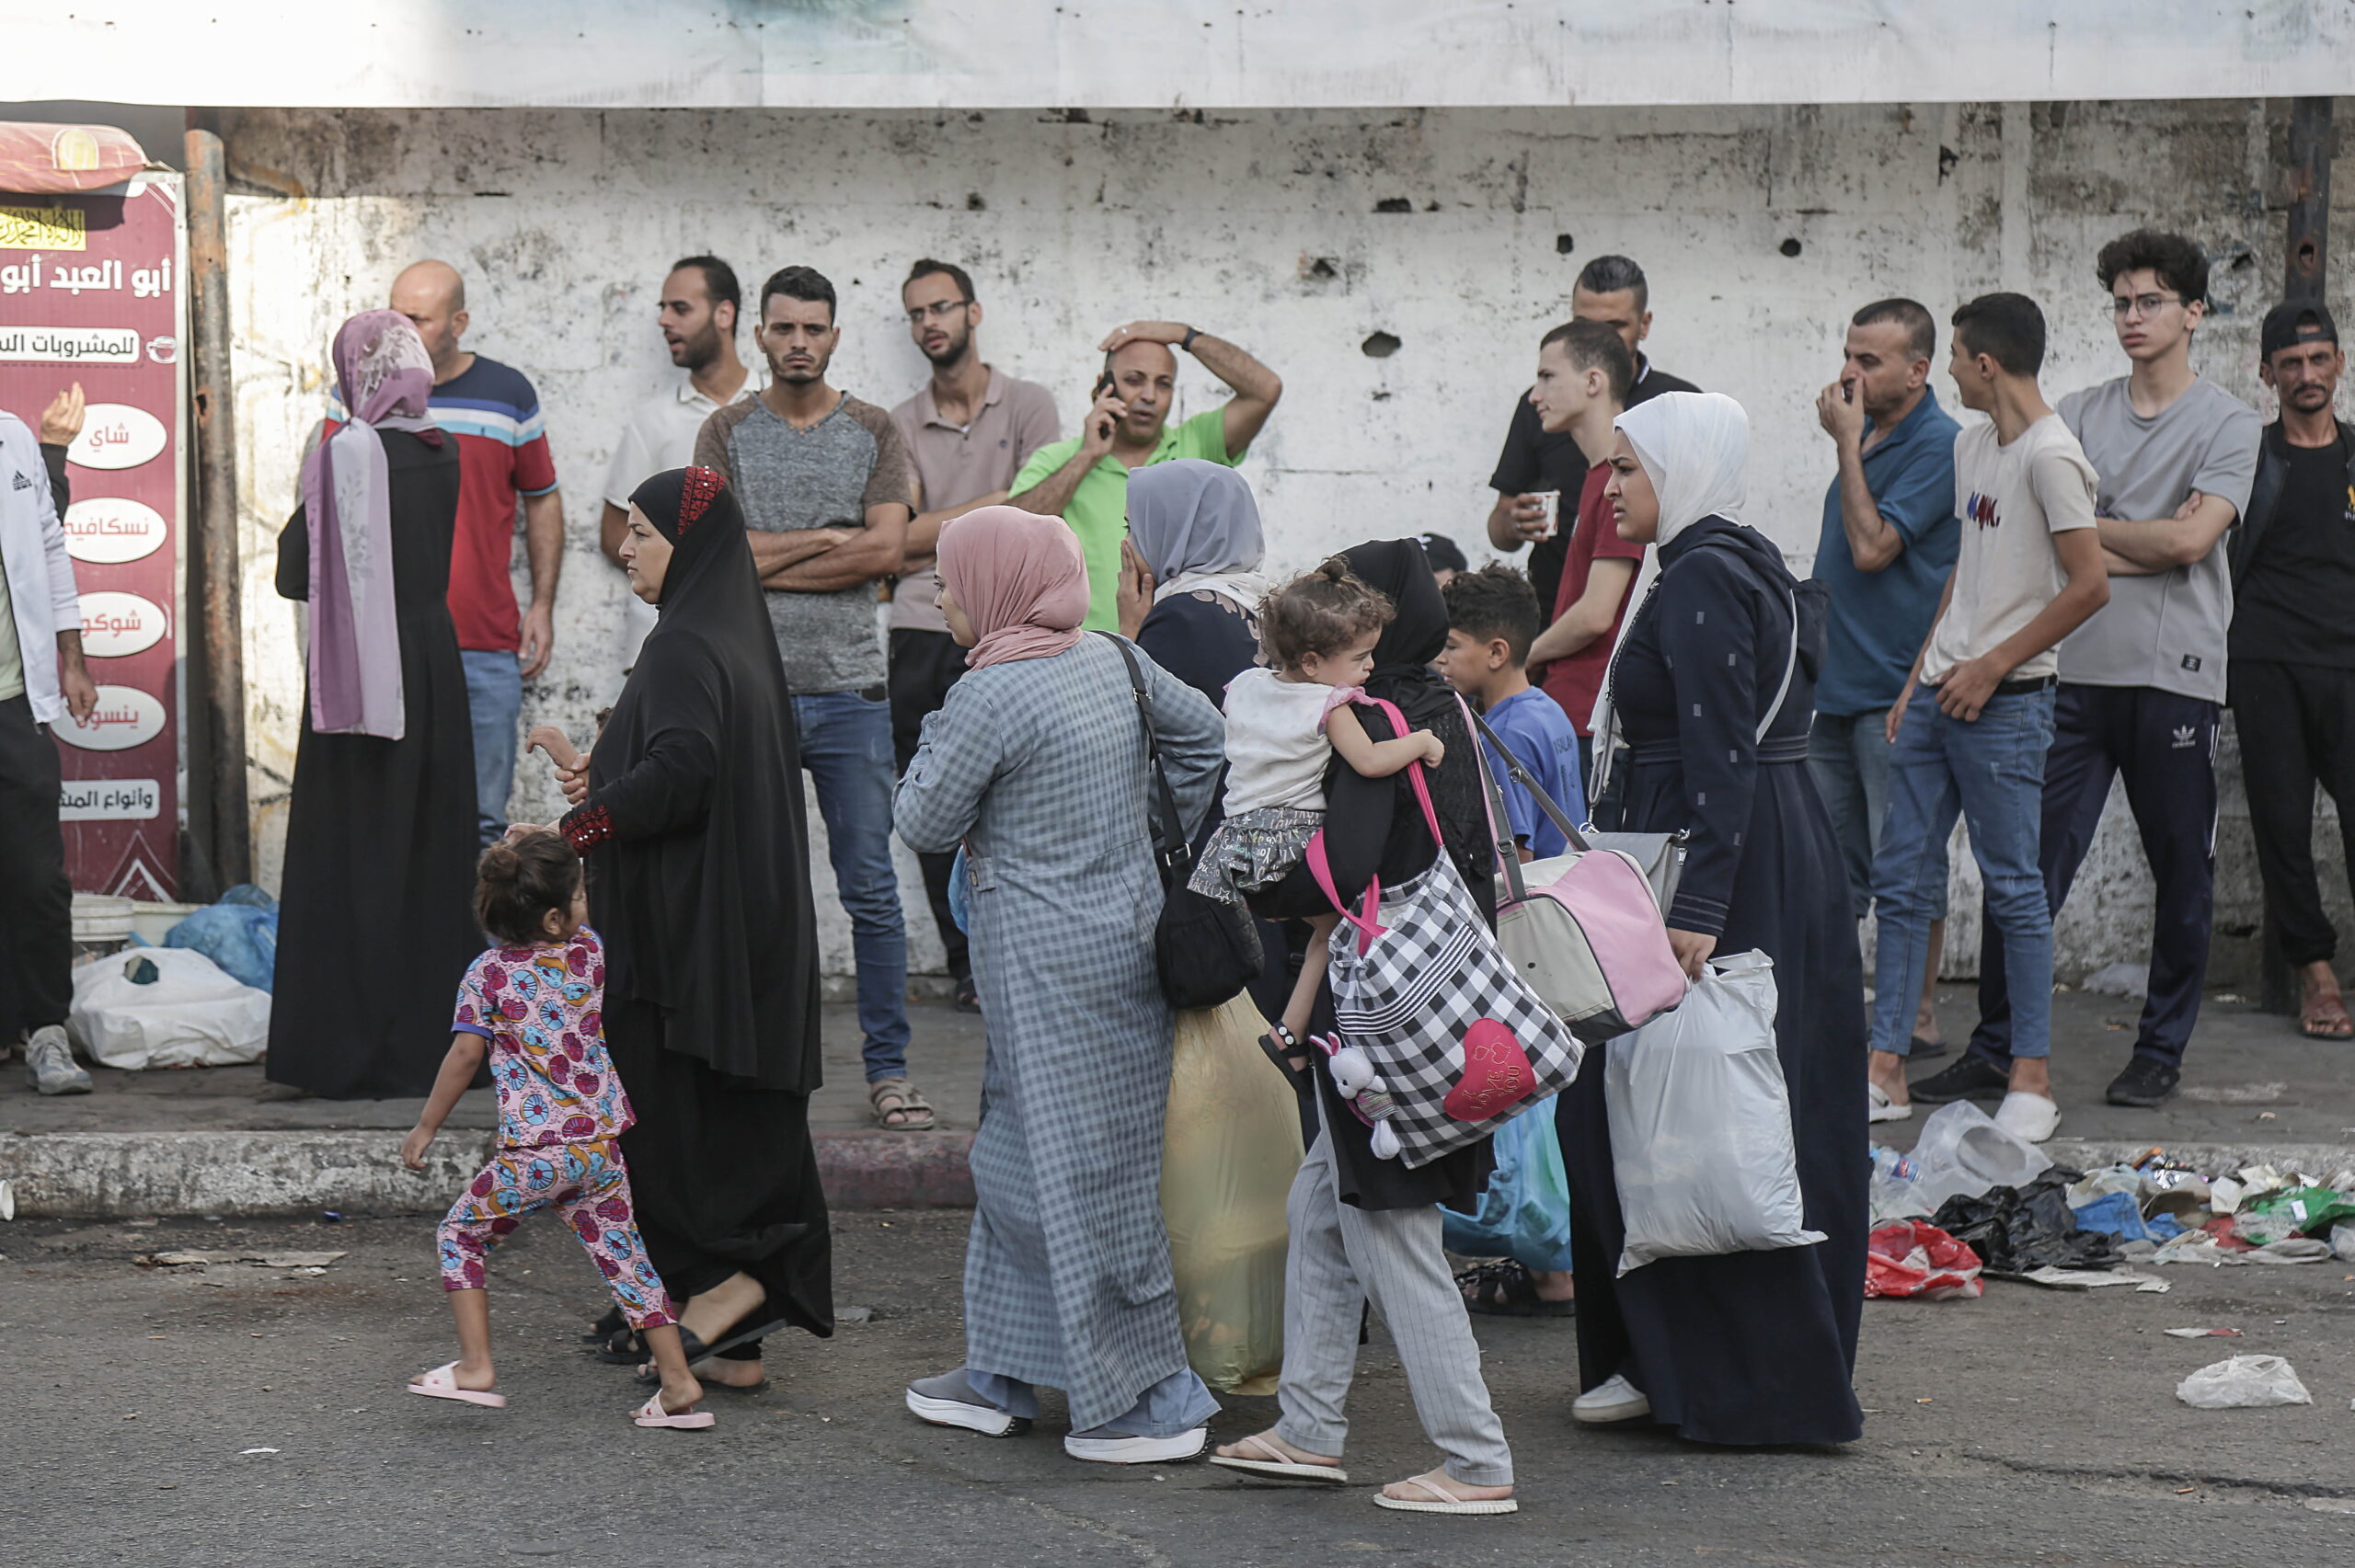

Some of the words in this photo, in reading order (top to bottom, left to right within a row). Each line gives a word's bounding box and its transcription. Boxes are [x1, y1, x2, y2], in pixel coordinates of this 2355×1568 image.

[0, 253, 41, 294] أبو
[50, 258, 122, 296] العبد
[131, 257, 171, 298] أبو
[31, 333, 134, 359] للمشروبات
[89, 421, 130, 452] شاي
[103, 787, 154, 810] وأنواع
[1469, 1070, 1505, 1110] LOVE
[1498, 1065, 1522, 1098] YOU
